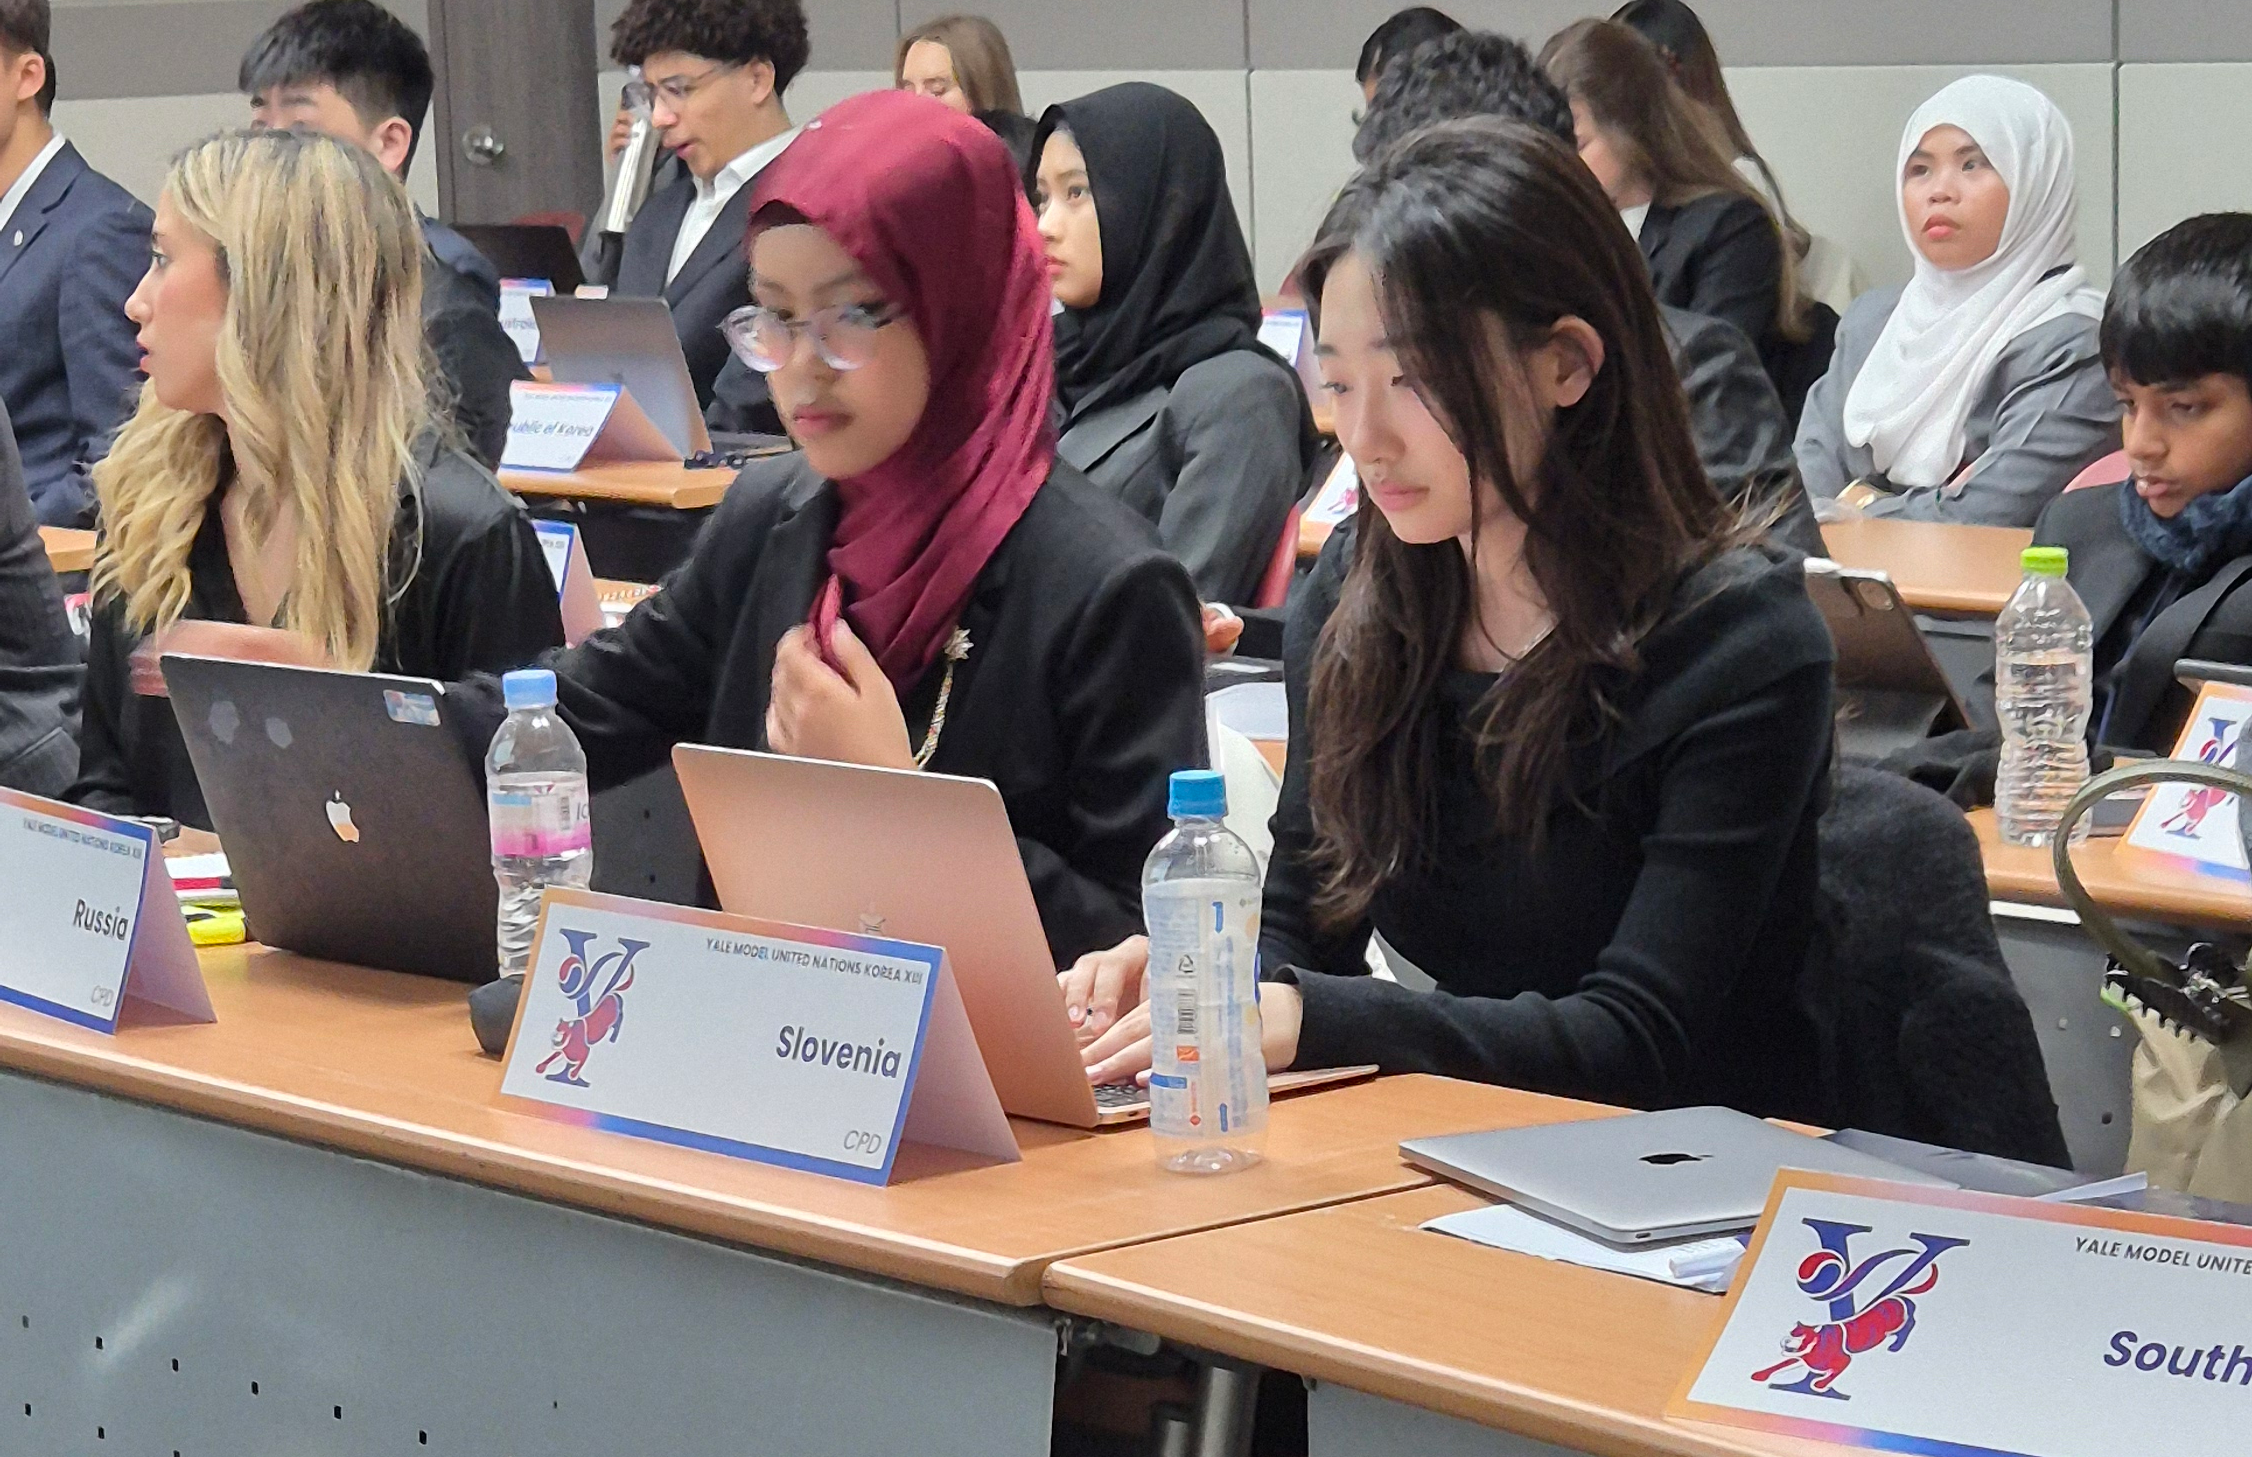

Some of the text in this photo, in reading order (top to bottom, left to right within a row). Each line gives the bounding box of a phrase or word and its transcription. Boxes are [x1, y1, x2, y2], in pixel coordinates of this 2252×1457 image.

[512, 420, 542, 434] ublic
[74, 899, 128, 940] Russia
[706, 938, 731, 954] YALE
[733, 944, 768, 960] MODEL
[771, 948, 810, 967] UNITED
[812, 956, 861, 974] NATIONS
[864, 965, 900, 982] KOREA
[776, 1025, 902, 1078] Slovenia
[843, 1130, 882, 1154] CPD
[2075, 1237, 2121, 1257] YALE
[2124, 1244, 2190, 1267] MODEL
[2103, 1330, 2252, 1386] South
